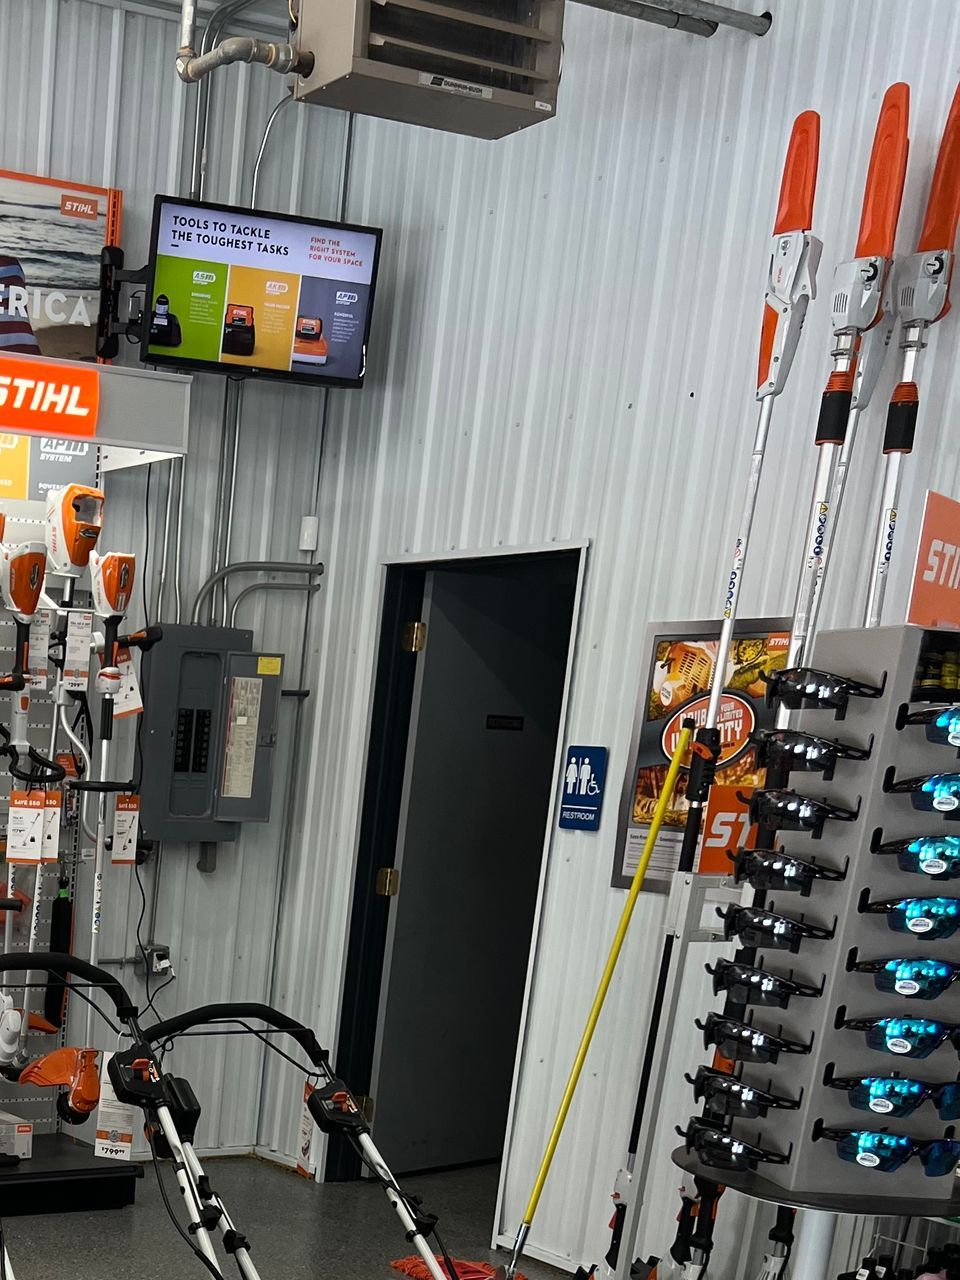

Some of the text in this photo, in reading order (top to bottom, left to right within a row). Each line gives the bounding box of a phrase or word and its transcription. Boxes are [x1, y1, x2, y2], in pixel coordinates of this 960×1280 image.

[64, 201, 94, 215] STIHL
[173, 215, 271, 240] TOOLS TO TACKLE
[171, 229, 289, 257] THE TOUGHEST TASKS
[310, 236, 341, 247] FIND THE
[309, 245, 356, 258] RIGHT SYSTEM
[308, 253, 364, 267] FOR YOUR SPACE
[39, 453, 73, 463] SYSTEM
[720, 702, 735, 712] YOUR
[561, 811, 595, 821] RESTROOM
